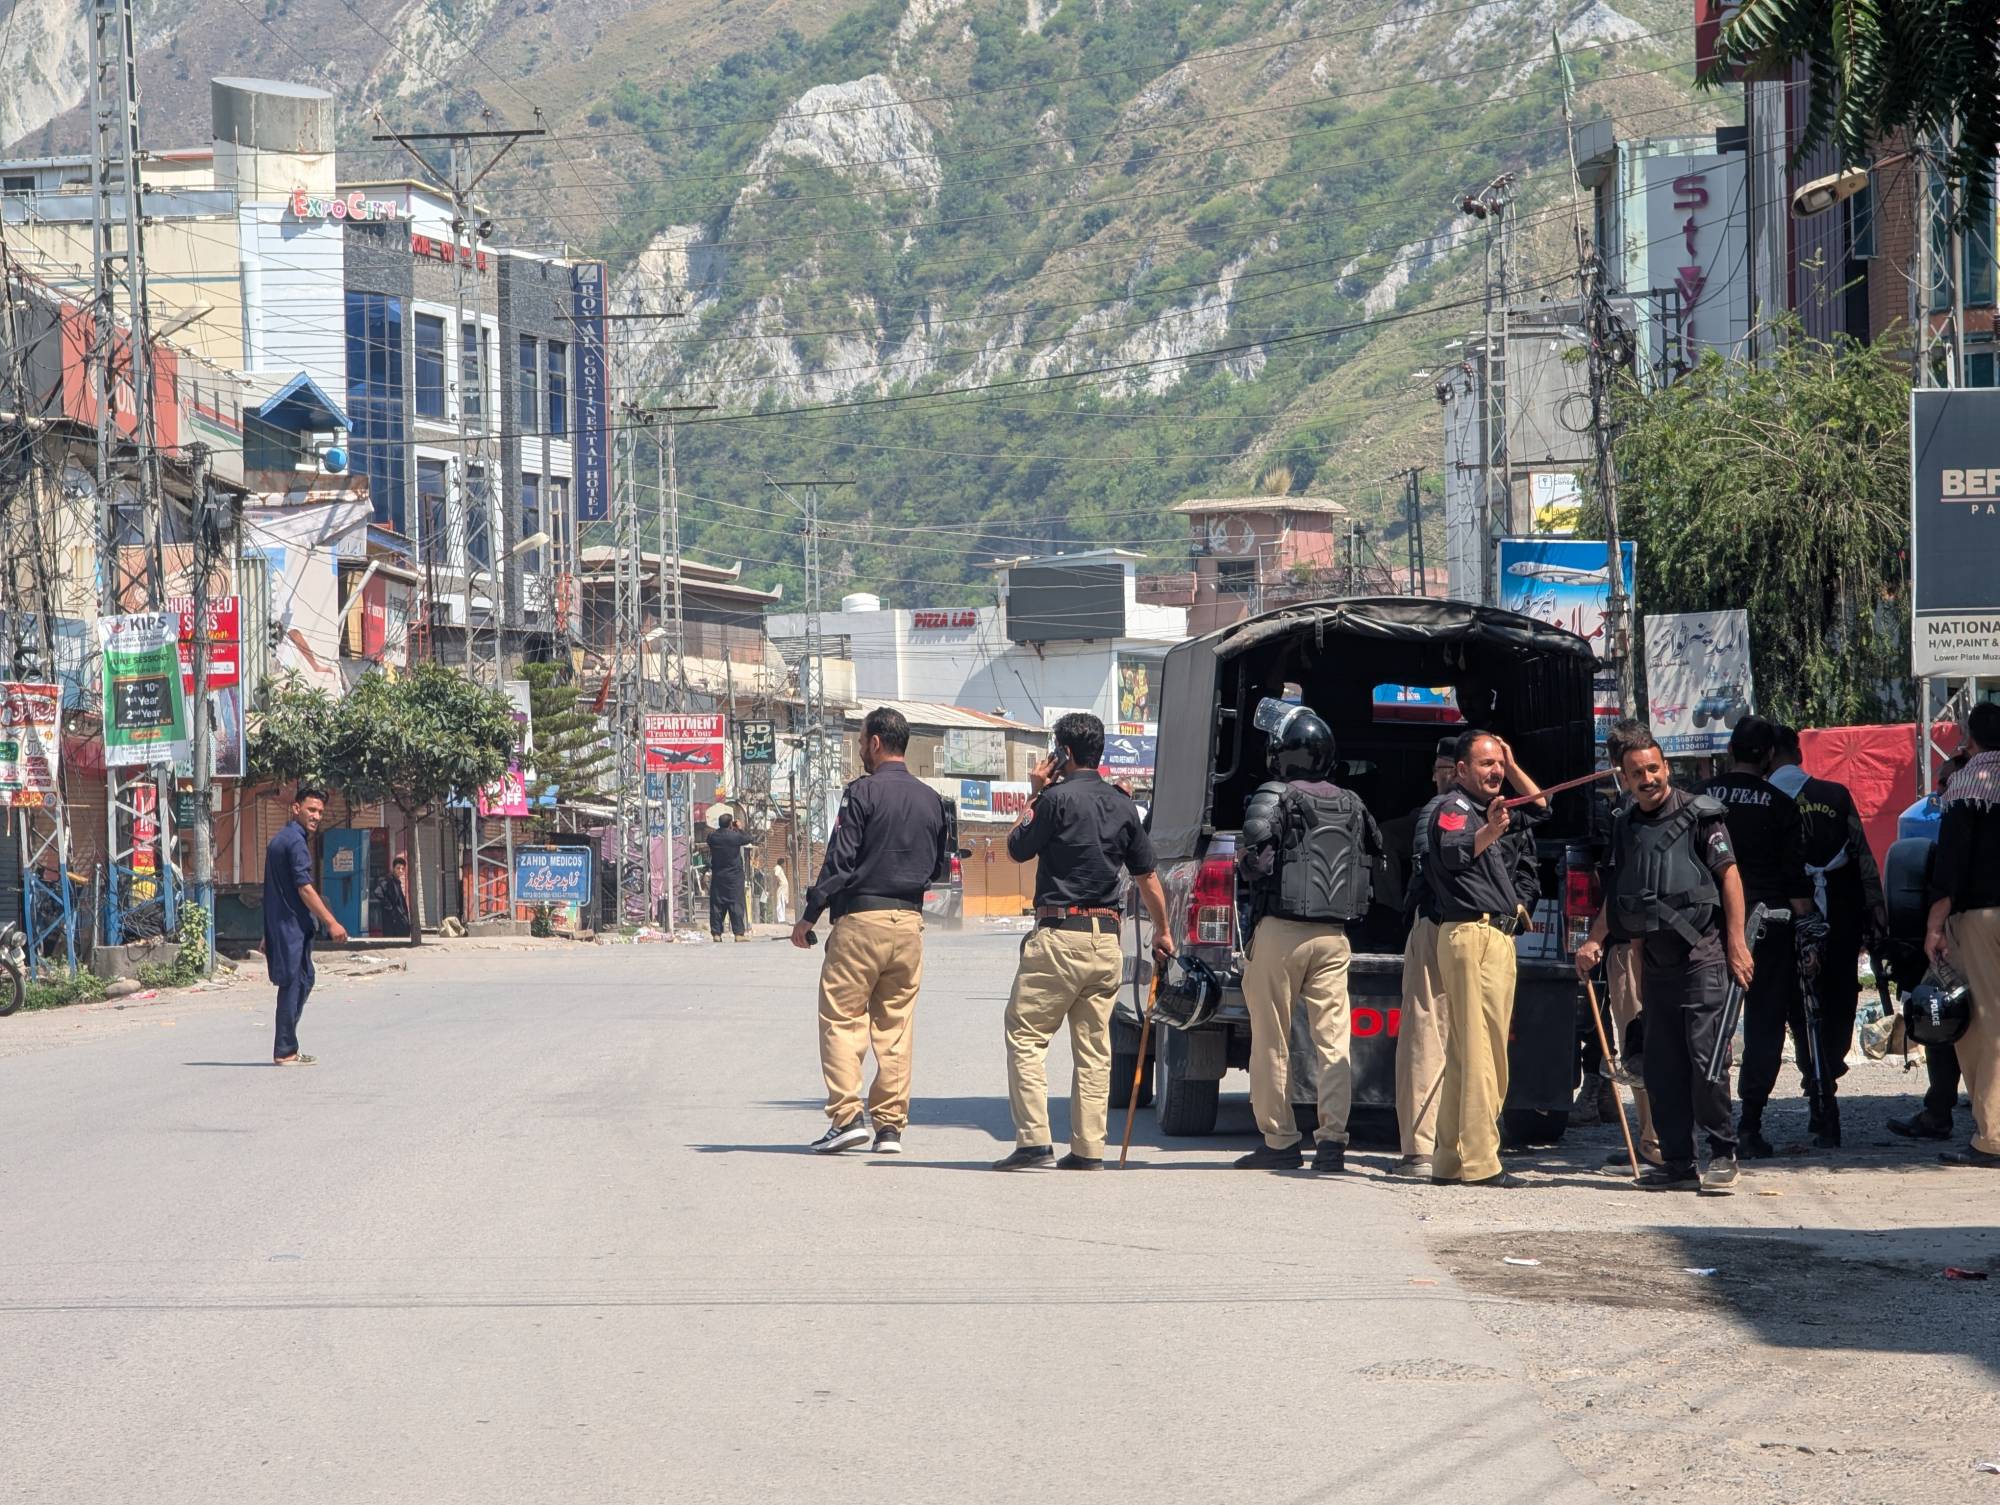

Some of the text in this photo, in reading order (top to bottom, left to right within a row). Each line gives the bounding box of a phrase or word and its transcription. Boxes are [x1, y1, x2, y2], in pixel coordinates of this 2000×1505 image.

[580, 284, 600, 516] ROYAL CONTINENTAL HOTEL
[130, 615, 168, 632] KIPS
[914, 611, 948, 628] PIZZA
[1928, 620, 2000, 635] NATIONA
[1991, 638, 1999, 648] &
[1934, 653, 1959, 662] Lower
[1960, 653, 1980, 661] Plate
[125, 696, 160, 707] 1st Year
[126, 709, 162, 720] 2nd Year
[648, 729, 713, 738] Travels & Tour
[743, 724, 771, 734] 3D
[1706, 785, 1772, 807] NO FEAR
[520, 855, 583, 868] ZAHID MEDICOS
[1929, 998, 1941, 1027] POLICE
